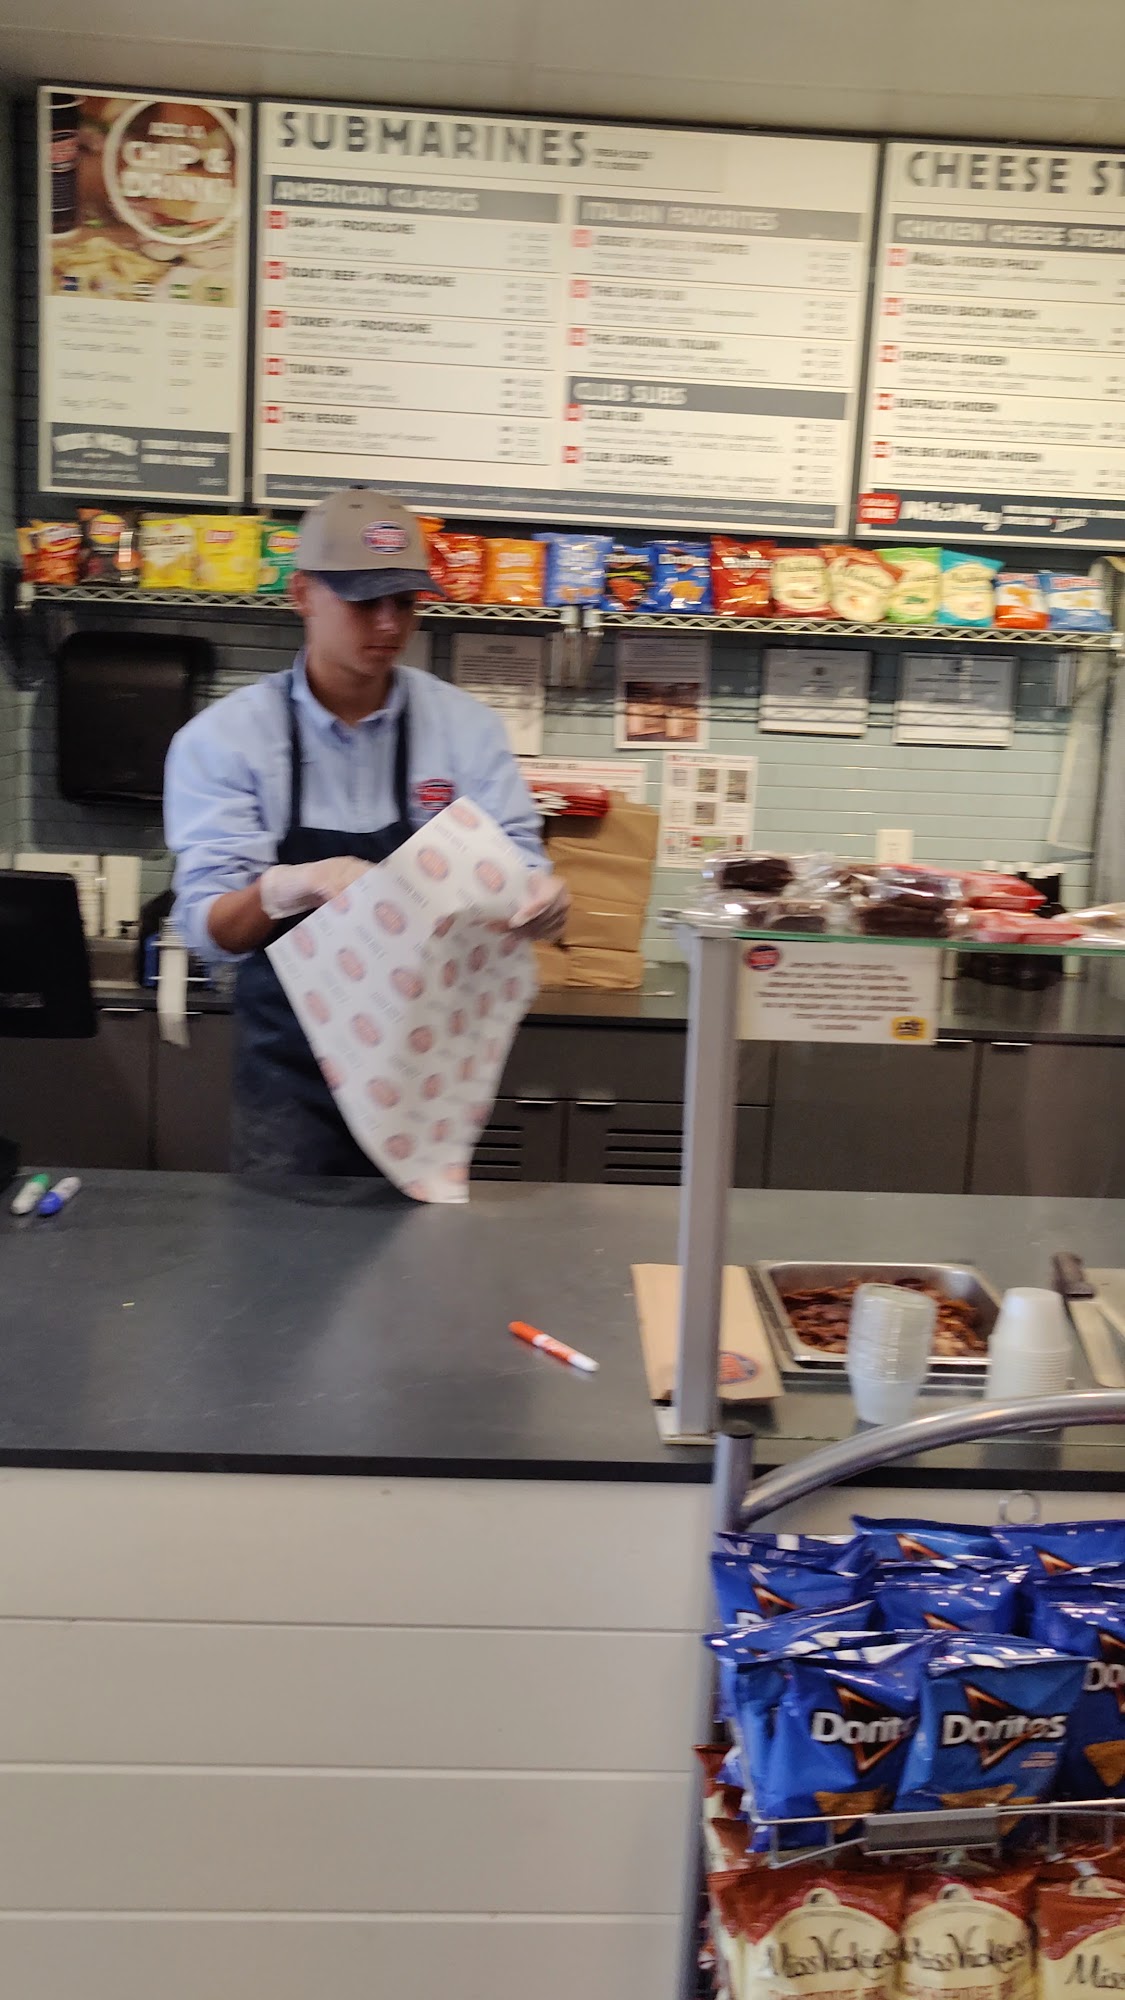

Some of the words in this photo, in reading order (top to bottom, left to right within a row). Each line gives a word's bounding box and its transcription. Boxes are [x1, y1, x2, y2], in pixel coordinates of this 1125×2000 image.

[278, 110, 587, 167] SUBMARINES
[121, 141, 200, 170] CHIP
[905, 150, 1069, 194] CHEESE
[273, 181, 388, 206] AMERICAN
[898, 219, 985, 242] CHICKEN
[988, 223, 1067, 247] CHEESE
[572, 381, 630, 403] CLUB
[631, 384, 689, 407] SUBS
[941, 1713, 1068, 1746] Doritos
